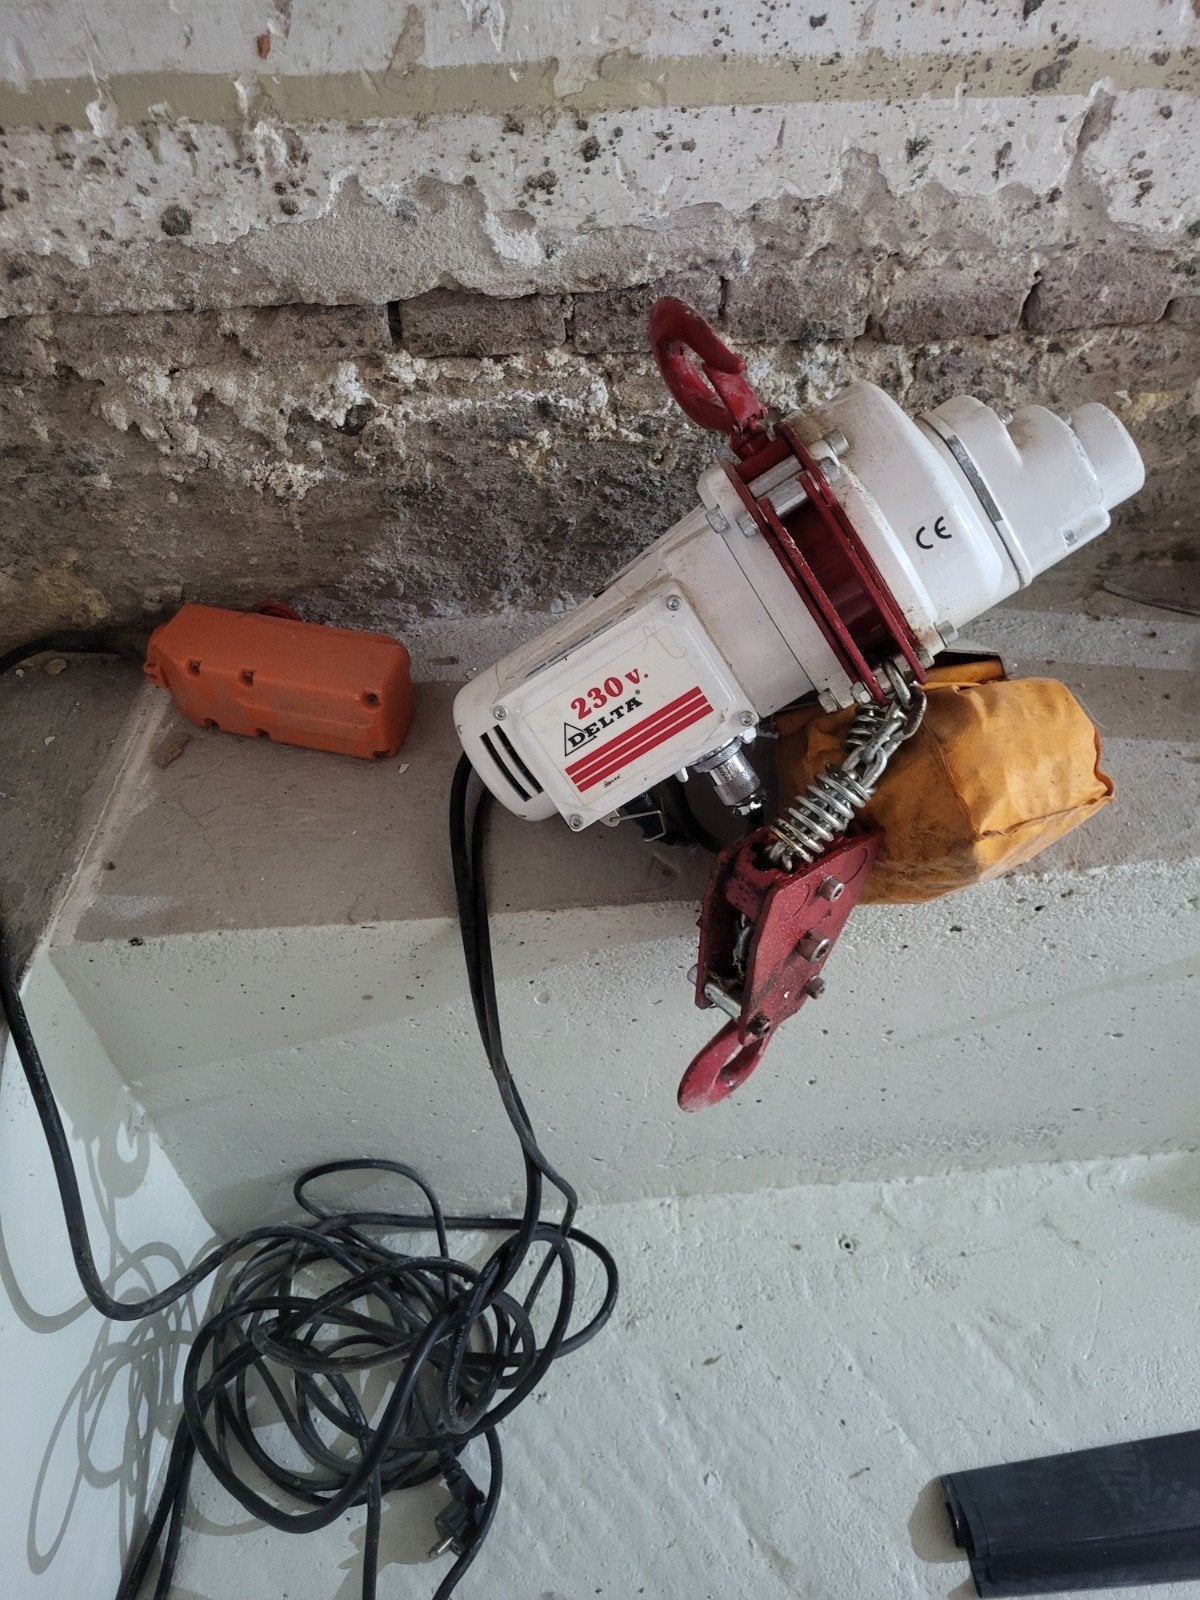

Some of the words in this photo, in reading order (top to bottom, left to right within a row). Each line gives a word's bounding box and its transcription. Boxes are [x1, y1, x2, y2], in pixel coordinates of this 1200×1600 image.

[916, 516, 952, 549] CE
[571, 677, 623, 720] 230
[568, 697, 643, 747] DELTA
